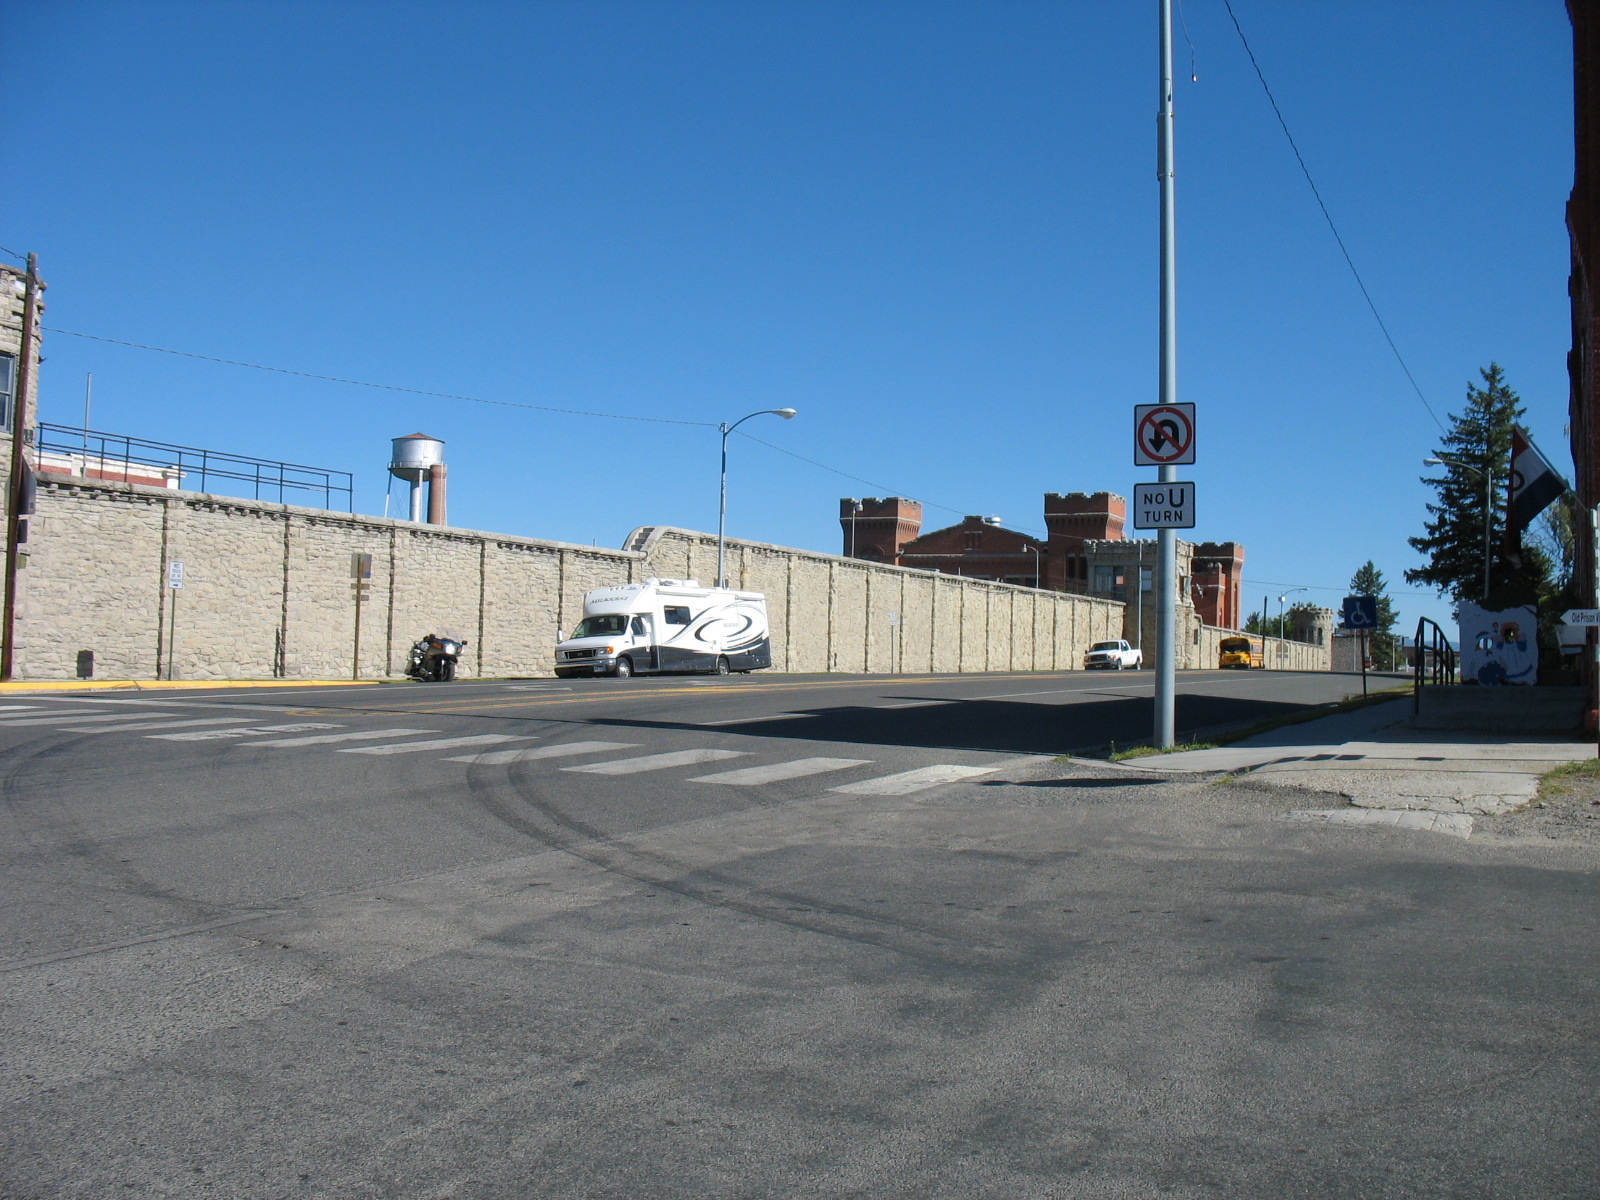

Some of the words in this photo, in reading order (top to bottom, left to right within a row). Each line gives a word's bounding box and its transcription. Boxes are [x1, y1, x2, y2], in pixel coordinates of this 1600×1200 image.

[1143, 493, 1165, 505] NO
[1169, 488, 1184, 508] U
[1144, 510, 1183, 523] TURN
[1572, 612, 1580, 622] Old
[1580, 612, 1595, 622] Prison
